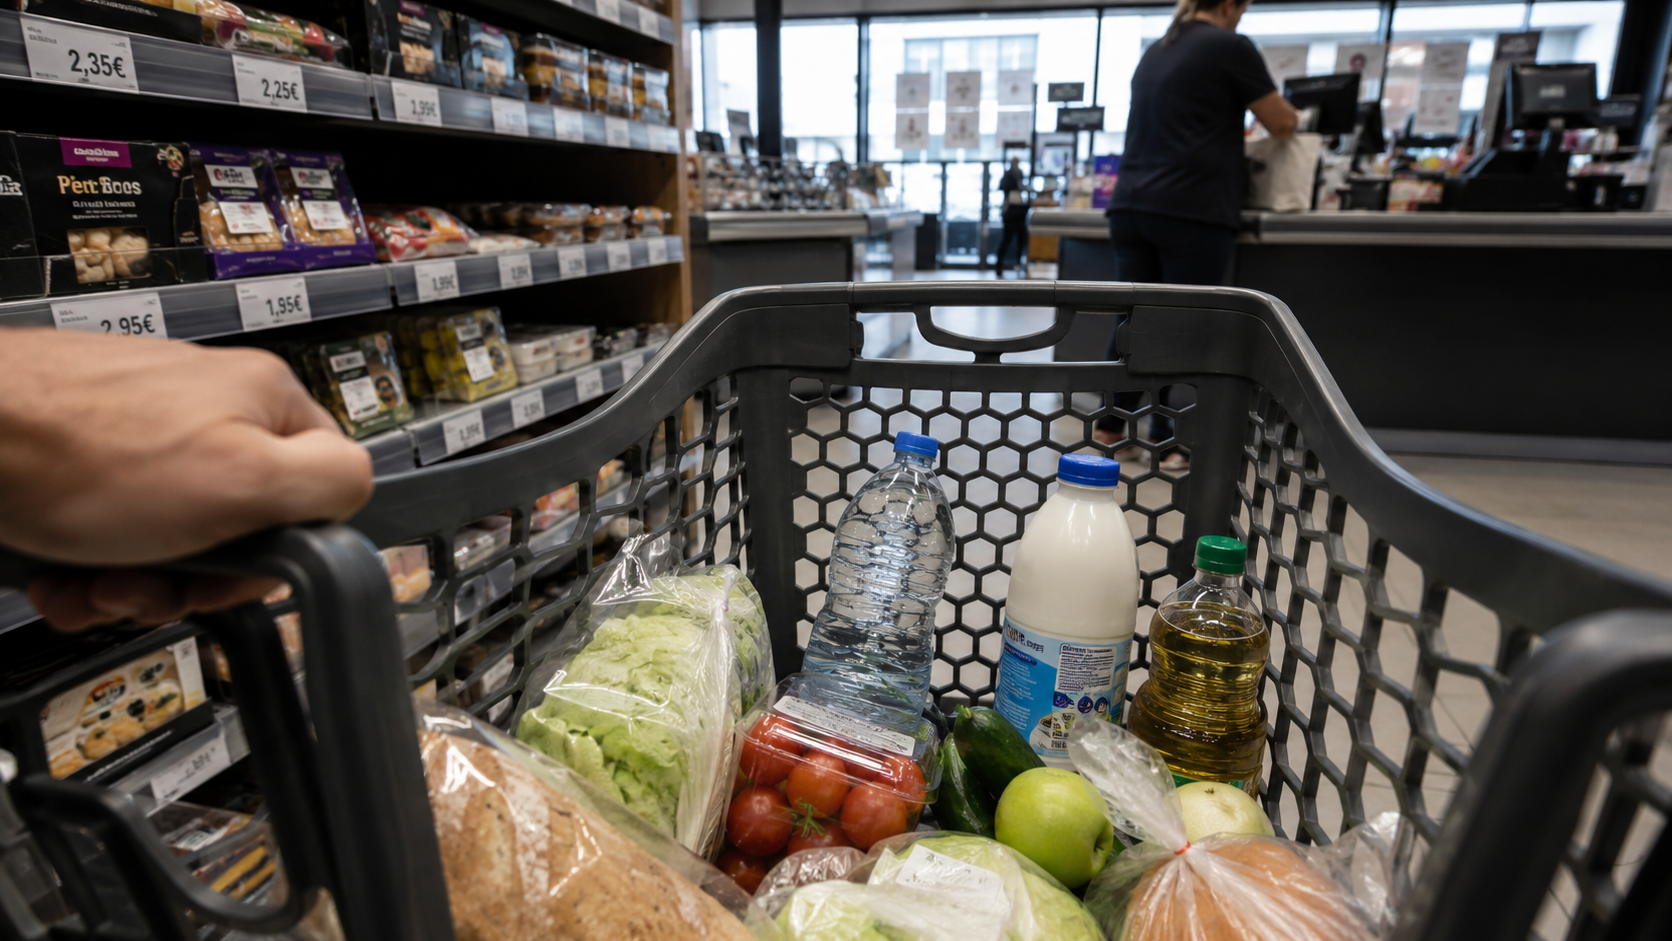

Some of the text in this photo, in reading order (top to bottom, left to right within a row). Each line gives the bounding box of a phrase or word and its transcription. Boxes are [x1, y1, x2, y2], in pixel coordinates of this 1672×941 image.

[68, 48, 127, 79] 2,35€
[261, 78, 300, 101] 2,25€
[265, 294, 303, 318] 1,95€
[100, 313, 156, 337] 295€
